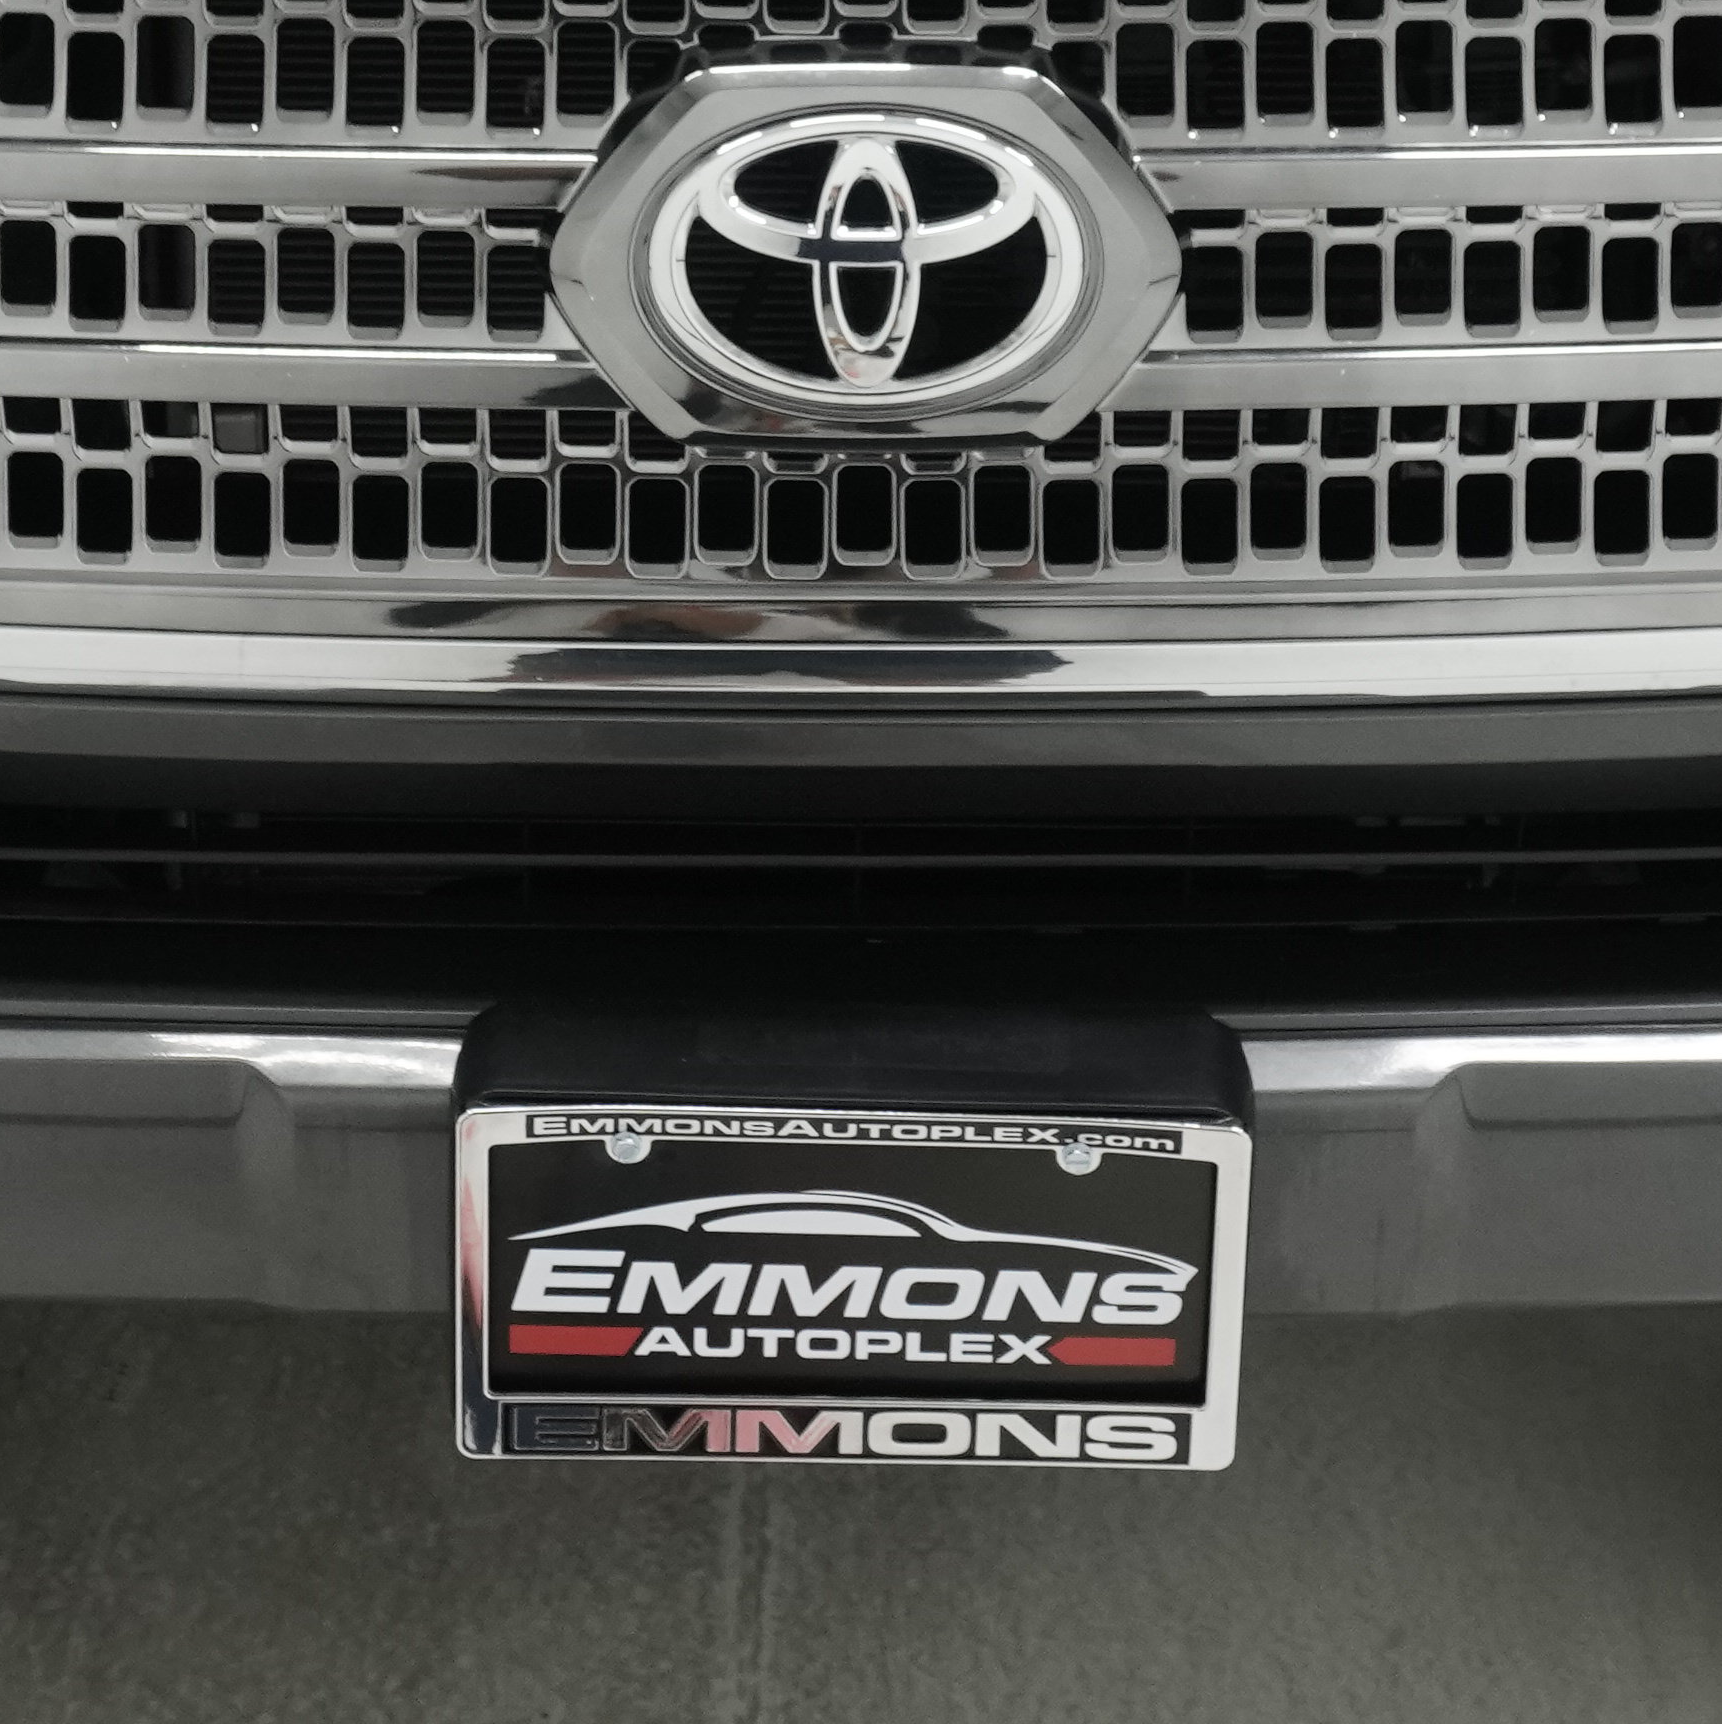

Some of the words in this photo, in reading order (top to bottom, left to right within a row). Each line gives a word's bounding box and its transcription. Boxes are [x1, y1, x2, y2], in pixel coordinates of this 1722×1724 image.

[511, 1248, 1185, 1325] EMMONS
[633, 1327, 1053, 1365] AUTOPLEX
[511, 1407, 1178, 1461] EMMONS
